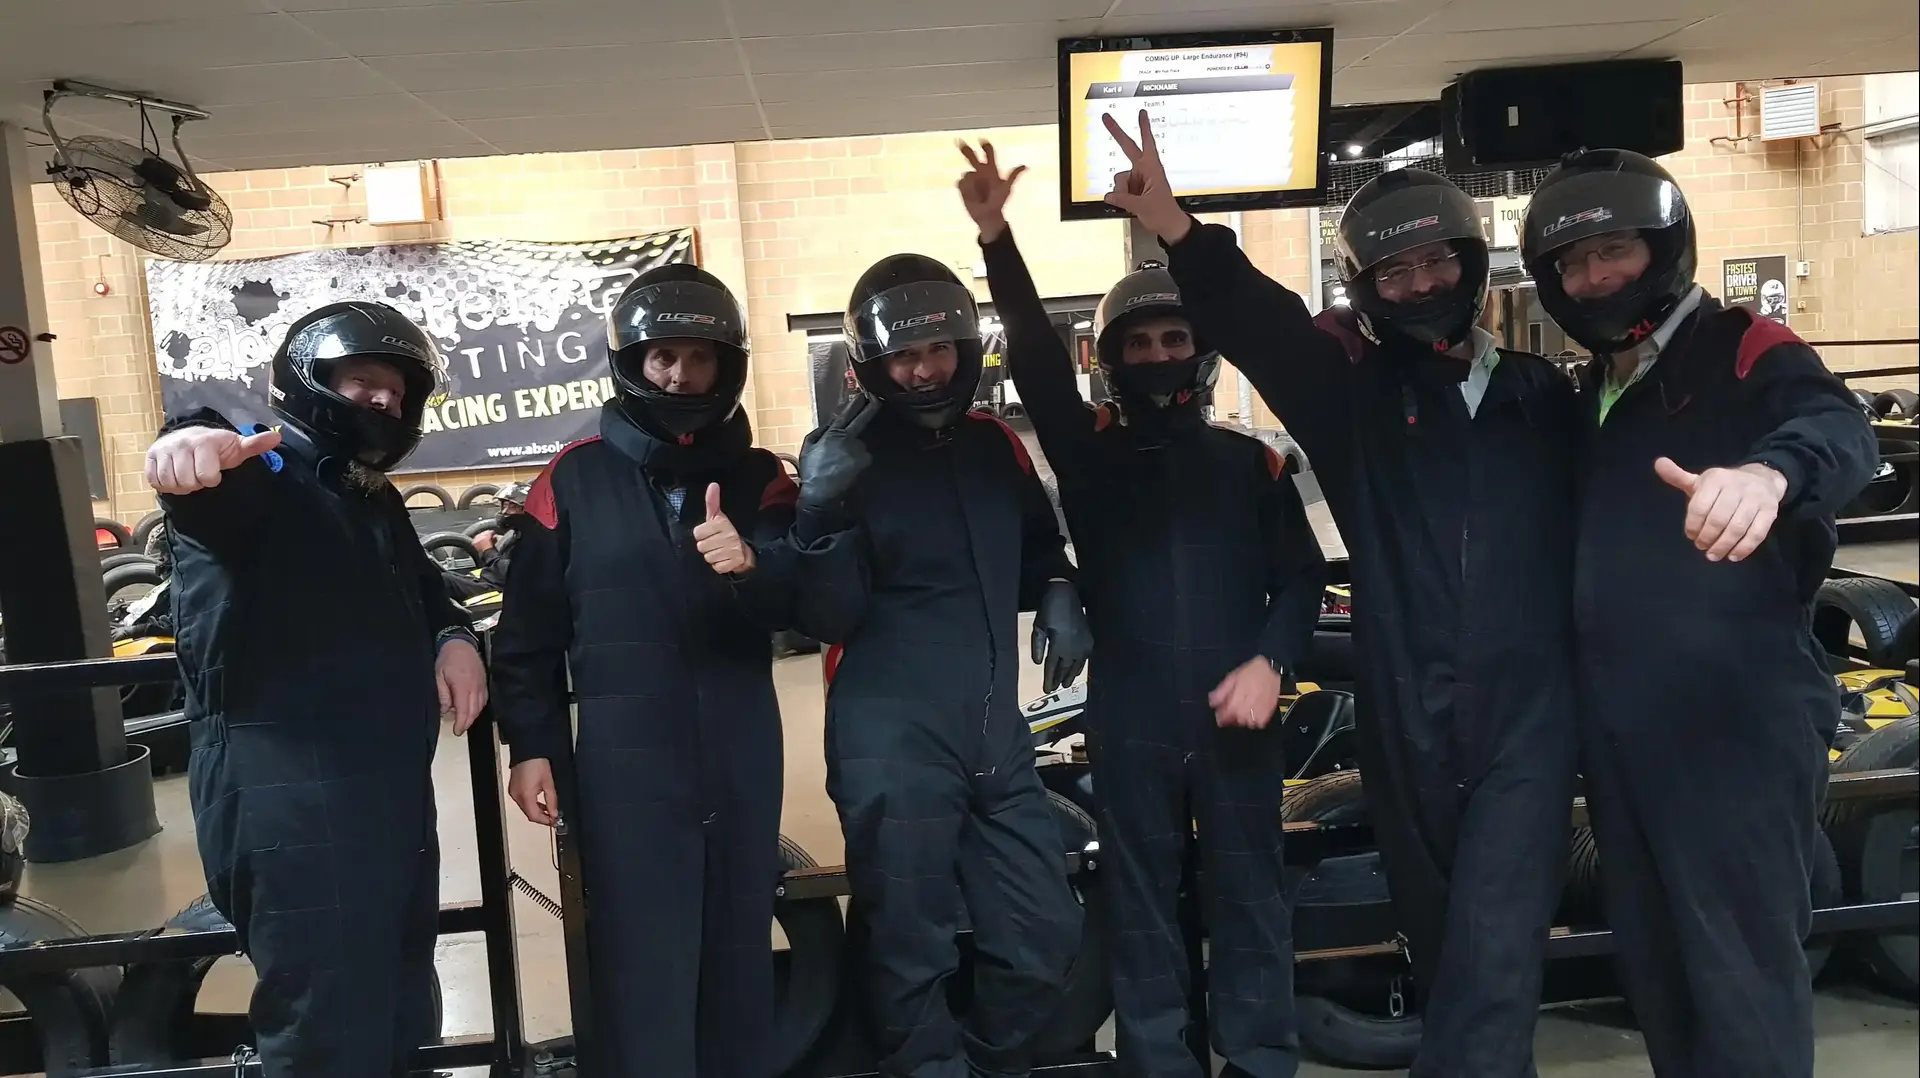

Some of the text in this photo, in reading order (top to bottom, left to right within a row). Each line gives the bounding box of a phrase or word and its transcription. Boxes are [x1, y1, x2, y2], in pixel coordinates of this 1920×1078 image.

[1183, 53, 1200, 61] Large
[1201, 51, 1233, 60] Endurance
[1102, 86, 1117, 94] Kart
[1143, 83, 1178, 92] NICKNAME
[1379, 215, 1440, 241] LS2
[1726, 262, 1757, 275] FASTEST
[1726, 273, 1758, 288] DRIVER
[1726, 286, 1735, 297] IN
[1735, 285, 1758, 297] TOWN?
[656, 312, 716, 325] LS2
[891, 312, 947, 332] LS2
[422, 375, 616, 434] ACING EXPERI
[487, 440, 573, 458] www.absol
